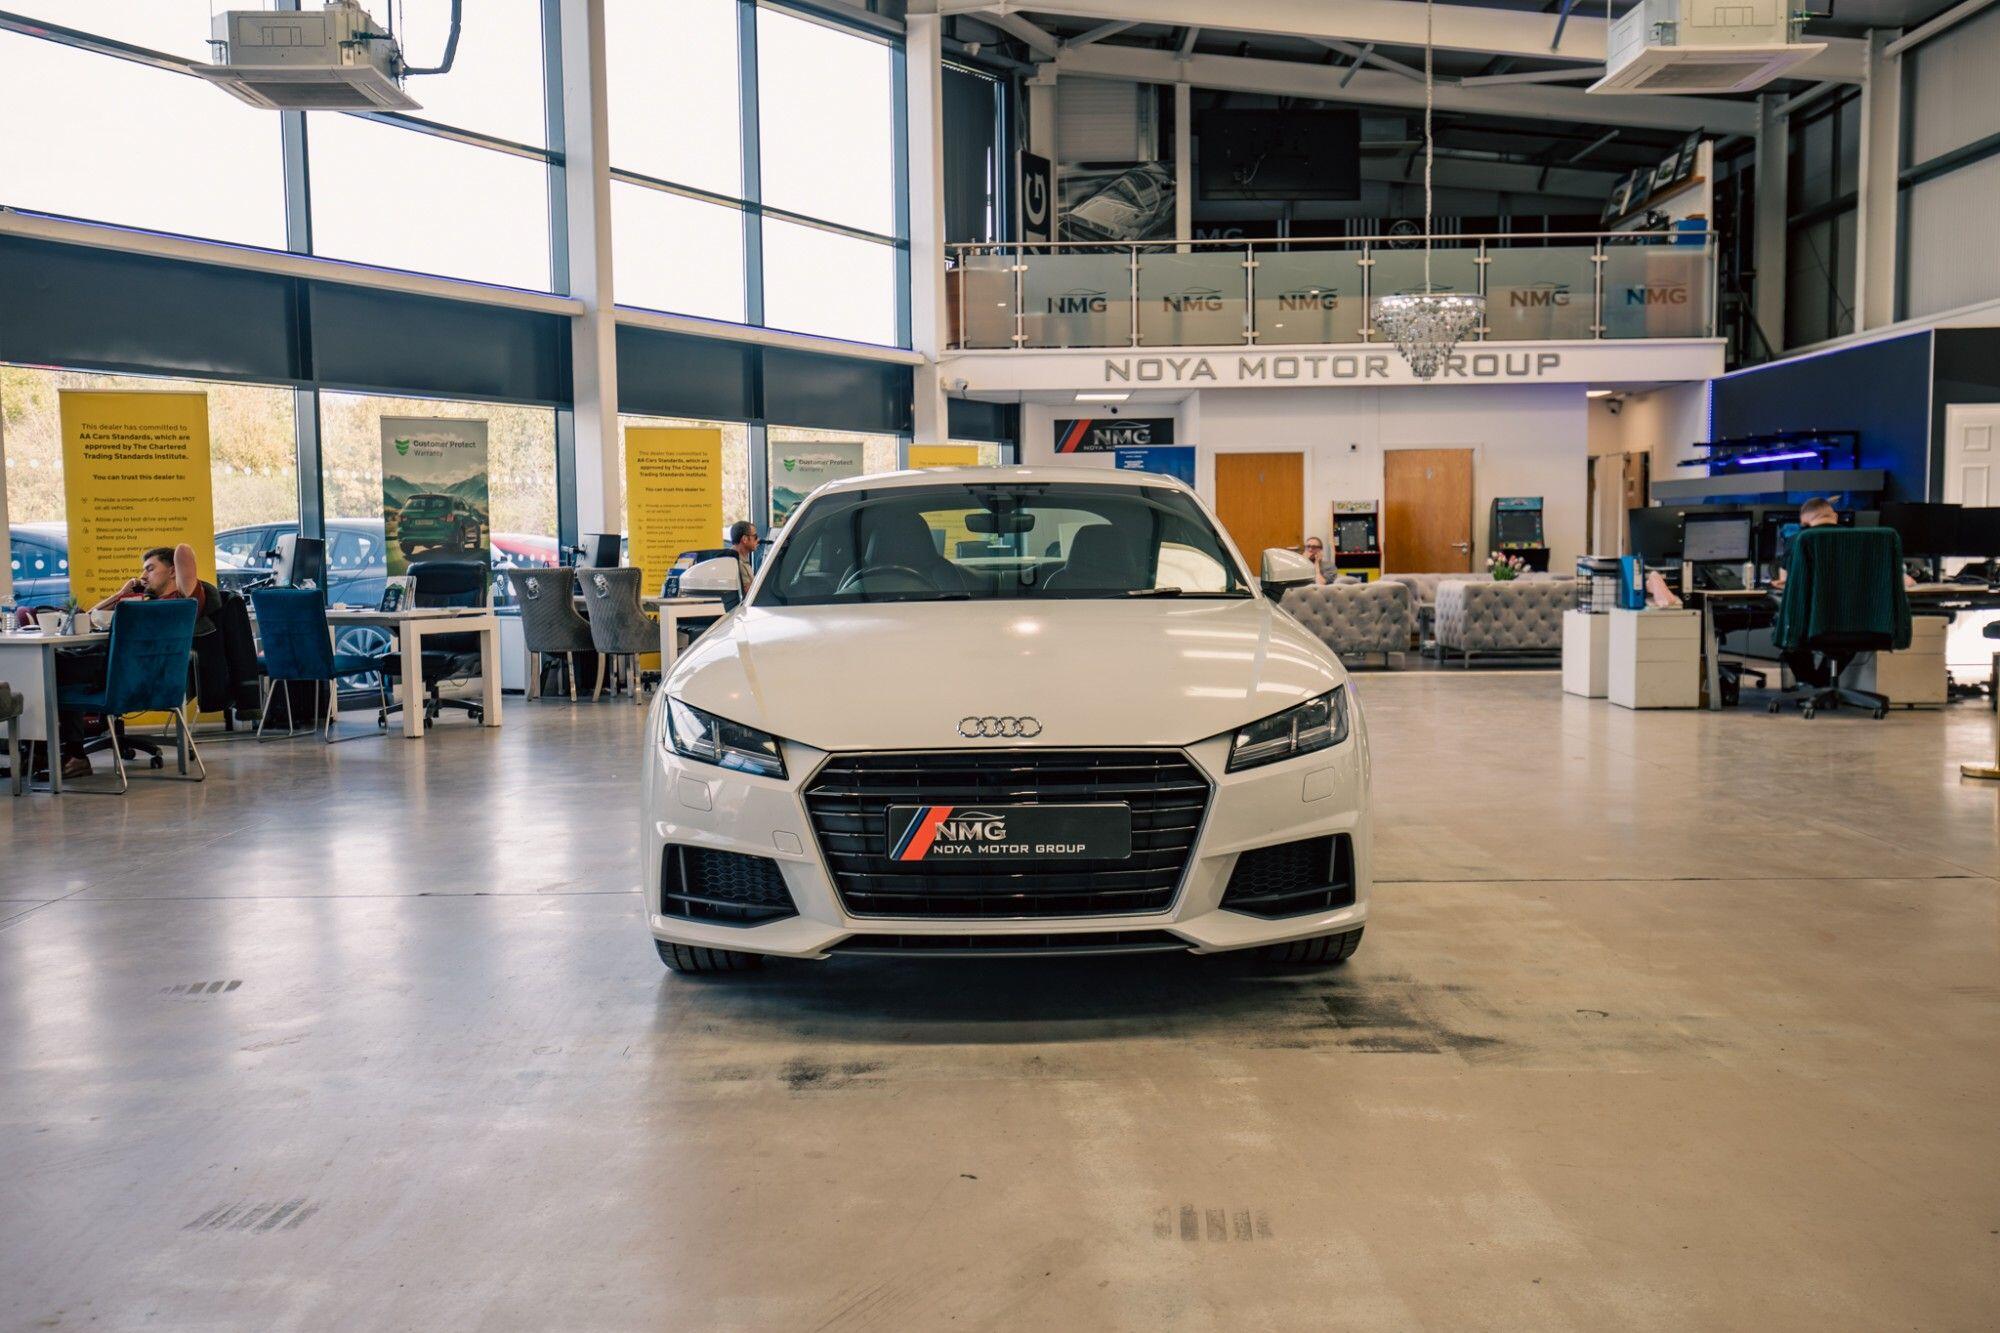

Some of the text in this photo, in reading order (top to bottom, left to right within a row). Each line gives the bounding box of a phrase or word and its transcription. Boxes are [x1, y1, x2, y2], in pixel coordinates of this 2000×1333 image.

[1048, 296, 1107, 314] NMG
[1163, 295, 1223, 313] NMG
[1278, 294, 1338, 311] NMG
[1510, 290, 1570, 307] NMG
[1626, 288, 1688, 305] NMG
[1105, 353, 1561, 382] NOYA MOTOR ROUP
[82, 423, 188, 431] This dealer has committed to
[413, 440, 476, 448] Customer Protect
[1093, 429, 1151, 445] NMG
[934, 821, 1007, 841] NMG
[933, 844, 1086, 854] NOYA MOTOR GROUP
